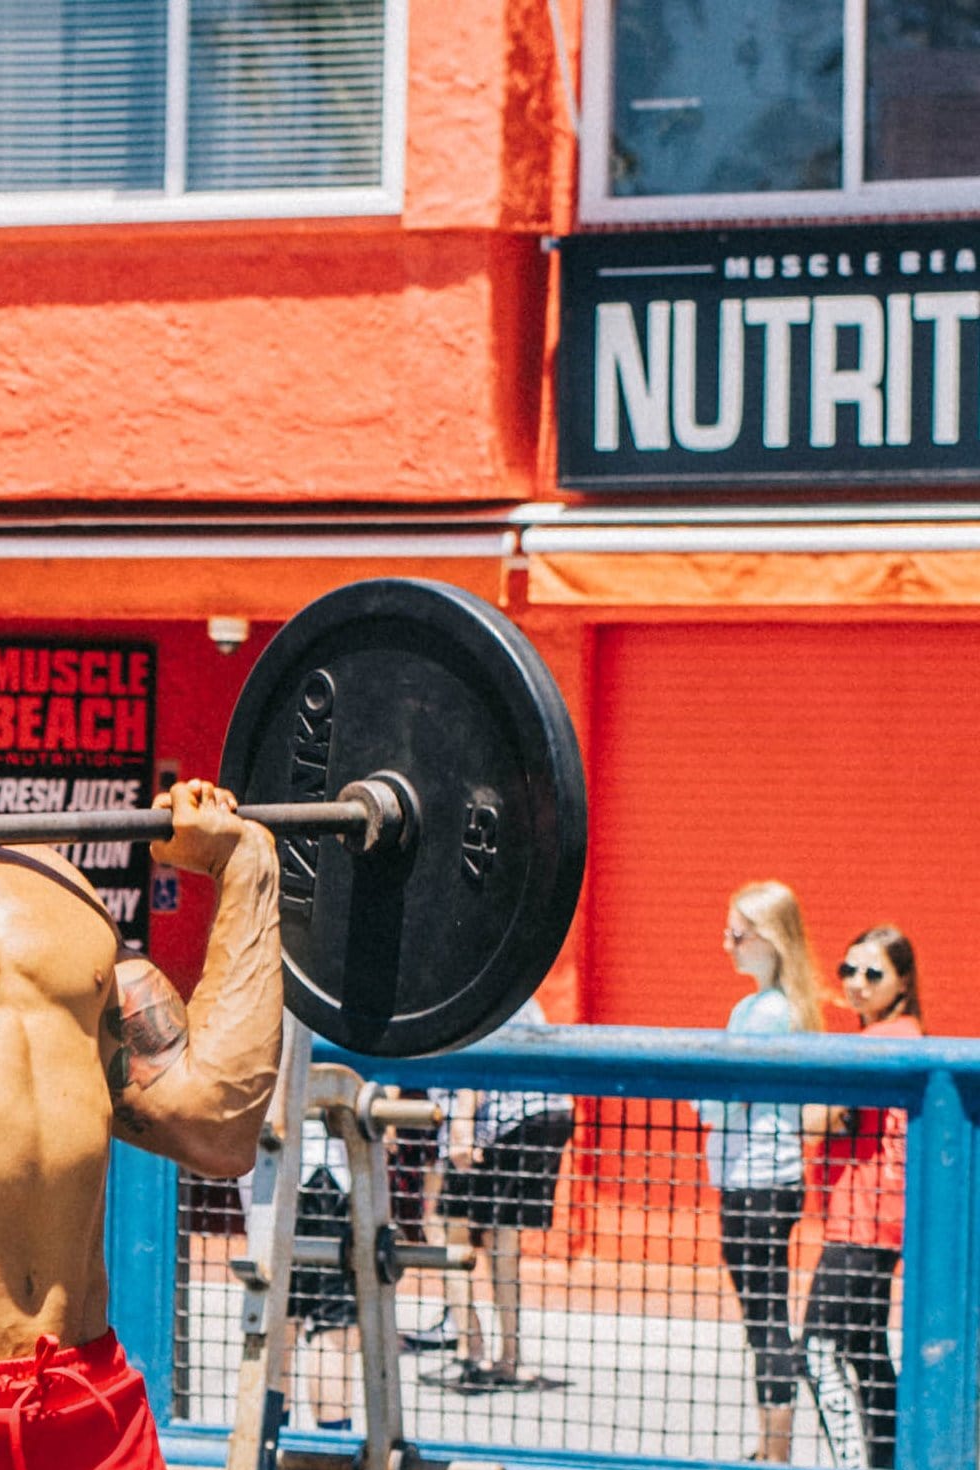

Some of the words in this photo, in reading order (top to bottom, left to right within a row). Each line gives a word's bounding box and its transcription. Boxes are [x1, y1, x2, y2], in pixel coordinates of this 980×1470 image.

[724, 251, 880, 279] MUSCLE
[594, 291, 980, 452] NUTRIT
[67, 778, 141, 813] JUICE
